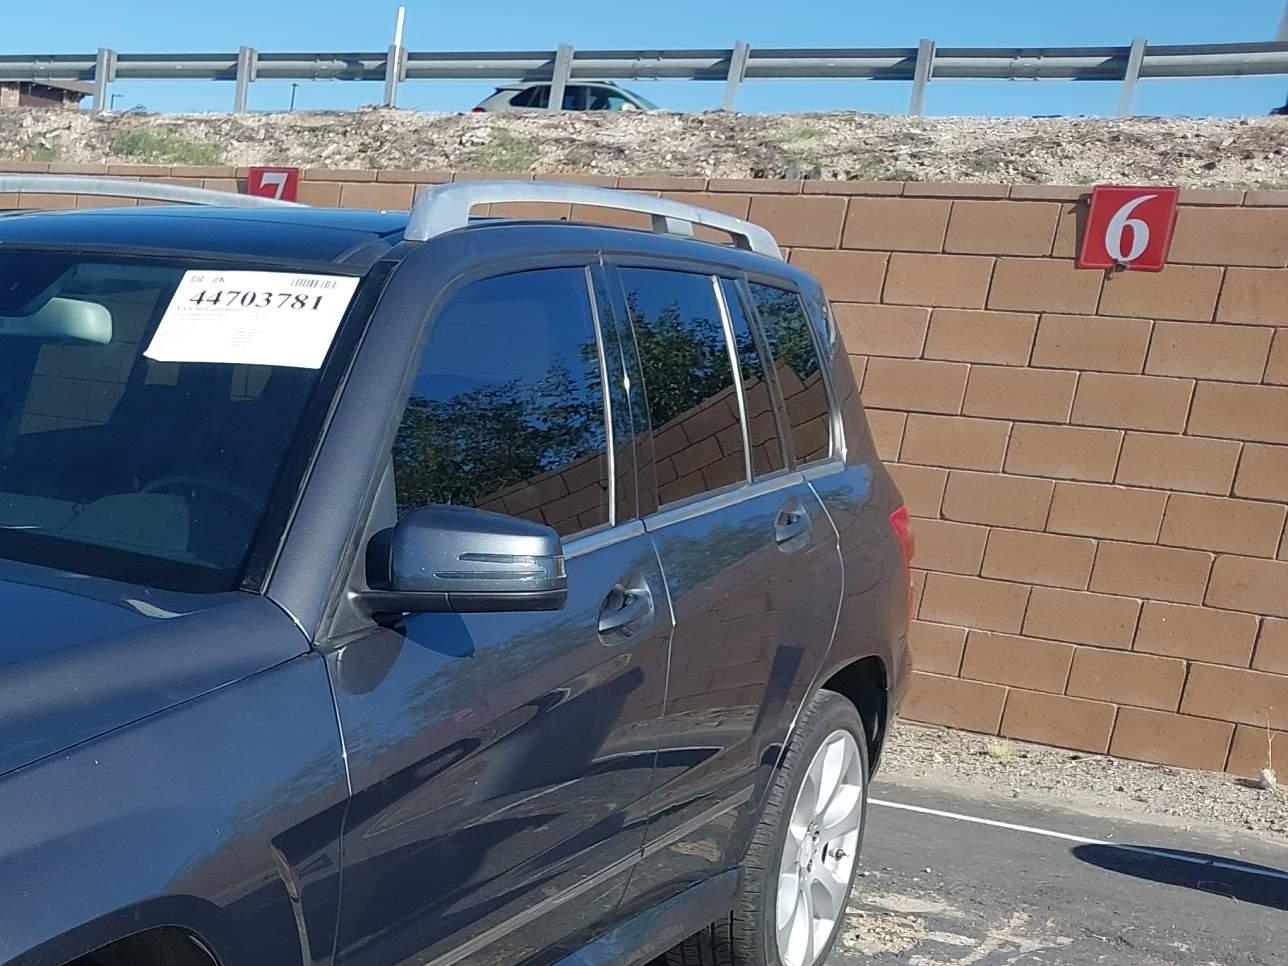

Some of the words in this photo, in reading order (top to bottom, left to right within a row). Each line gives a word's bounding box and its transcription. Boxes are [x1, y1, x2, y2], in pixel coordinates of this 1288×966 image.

[259, 172, 289, 200] 7
[1105, 194, 1159, 262] 6
[188, 288, 324, 311] 44703781
